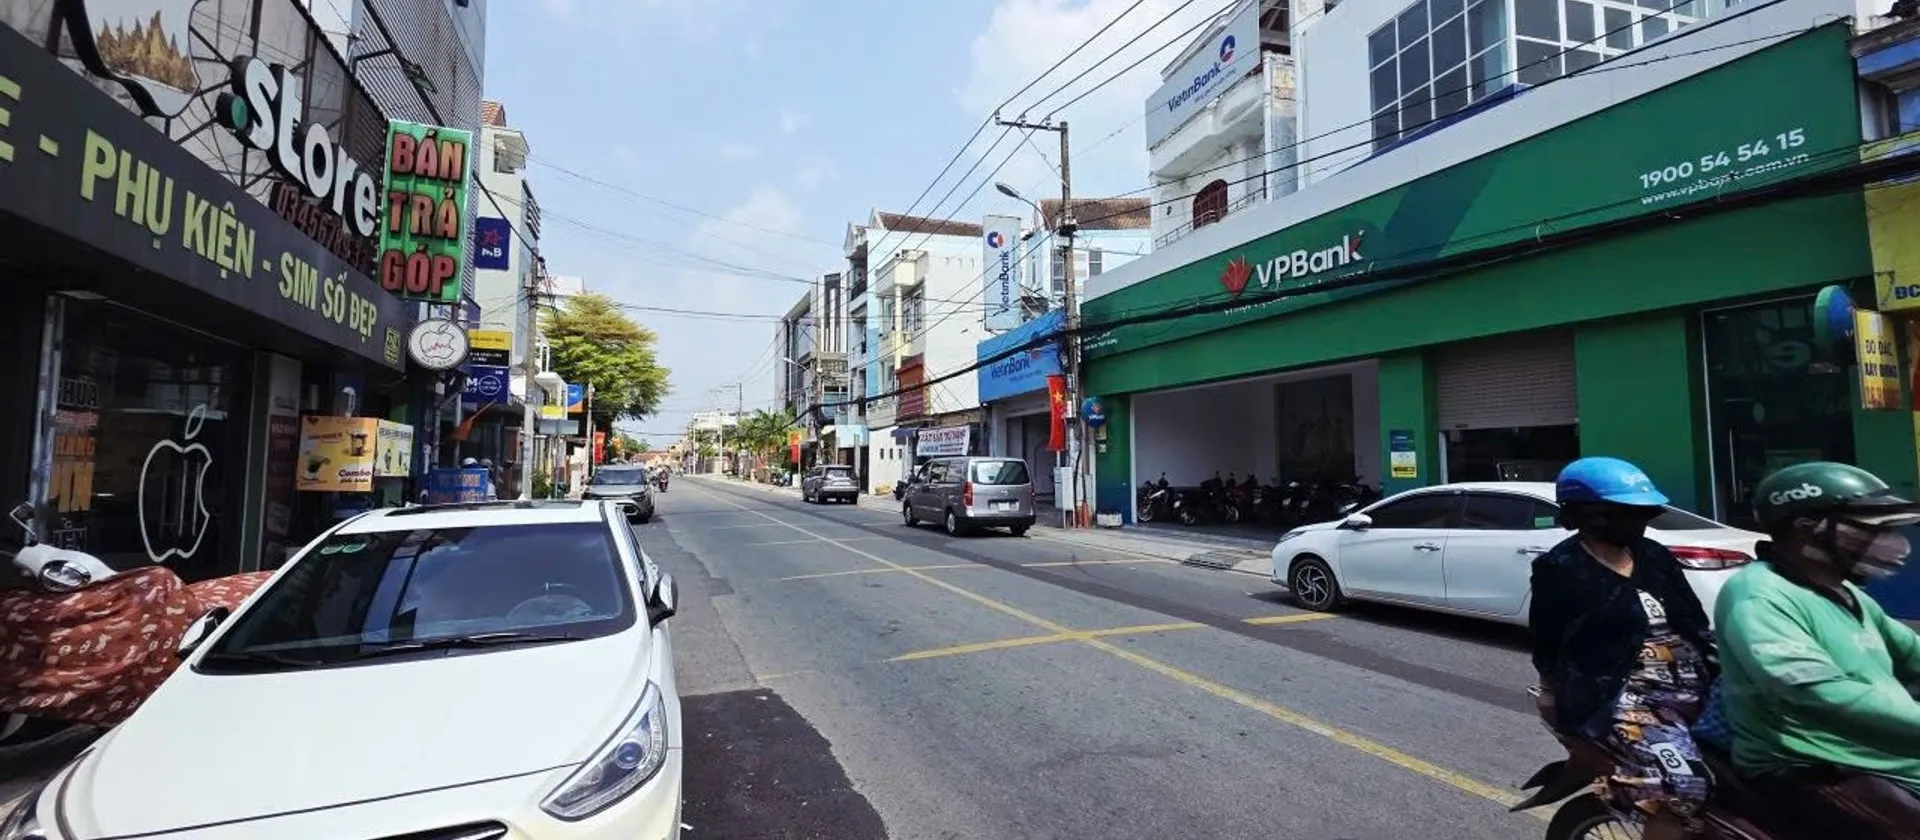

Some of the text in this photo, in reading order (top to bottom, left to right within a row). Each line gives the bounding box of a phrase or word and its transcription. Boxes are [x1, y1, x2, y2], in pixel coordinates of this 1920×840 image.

[1168, 61, 1221, 113] VietinBank
[391, 129, 464, 181] BÁN
[1639, 128, 1806, 189] 1900 54 54 15
[81, 128, 174, 250] PHỤ
[183, 192, 256, 279] KIỆN
[278, 252, 318, 311] SIM
[322, 272, 348, 325] SỐ
[349, 292, 377, 343] ĐẸP
[389, 187, 459, 239] TRẢ
[381, 244, 455, 296] GÓP
[999, 250, 1010, 314] VietinBank
[1256, 229, 1366, 288] VPBank
[1769, 483, 1822, 505] Grab
